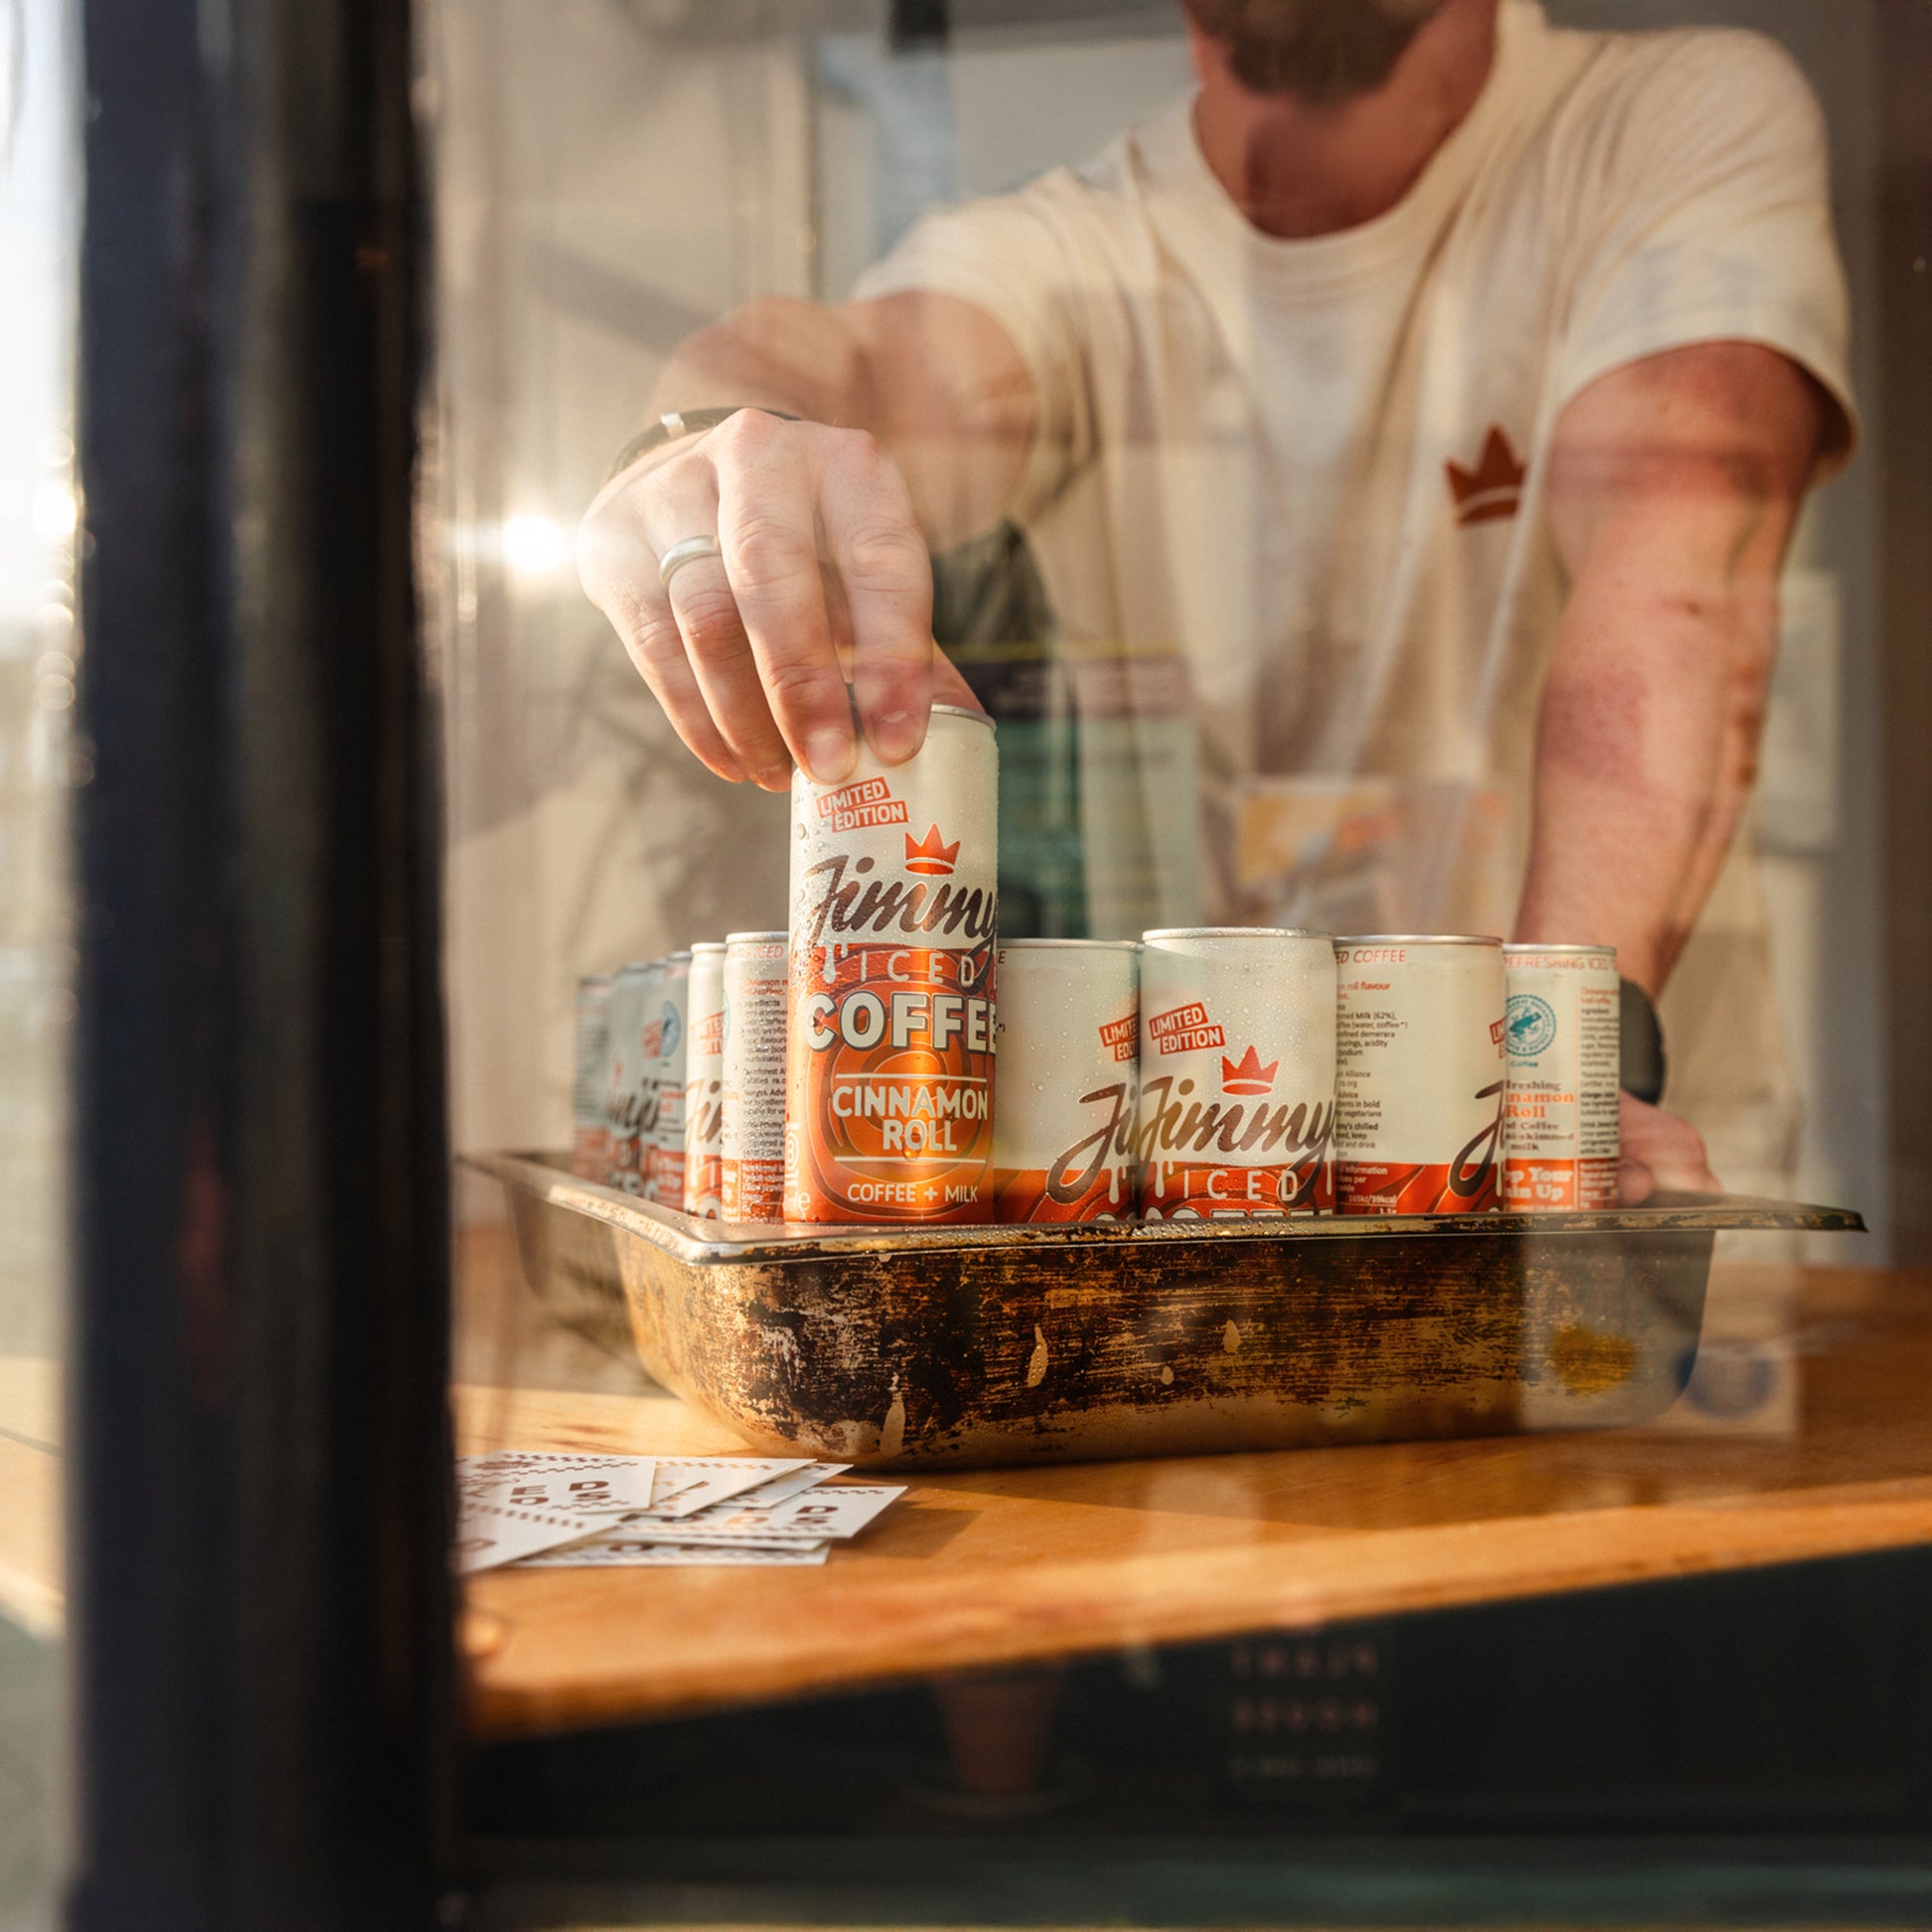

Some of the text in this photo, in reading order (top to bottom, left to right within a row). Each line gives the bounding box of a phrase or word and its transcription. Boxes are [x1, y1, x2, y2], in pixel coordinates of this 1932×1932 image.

[819, 780, 887, 815] LIMITED
[833, 802, 906, 832] EDITION
[1353, 950, 1407, 963] COFFEE
[860, 950, 976, 989] ICED
[1360, 981, 1391, 990] flavour
[1151, 1006, 1203, 1036] LIMITED
[1162, 1028, 1222, 1052] EDITION
[831, 1084, 988, 1121] CINNAMON
[1363, 1099, 1381, 1109] bold
[1505, 1105, 1546, 1118] Roll
[1344, 1110, 1382, 1120] vegetarians
[882, 1119, 958, 1152] ROLL
[1351, 1132, 1369, 1141] keep
[1354, 1122, 1379, 1131] chilled
[846, 1182, 917, 1203] COFFEE
[944, 1185, 979, 1203] MILK
[1182, 1169, 1299, 1201] ICED
